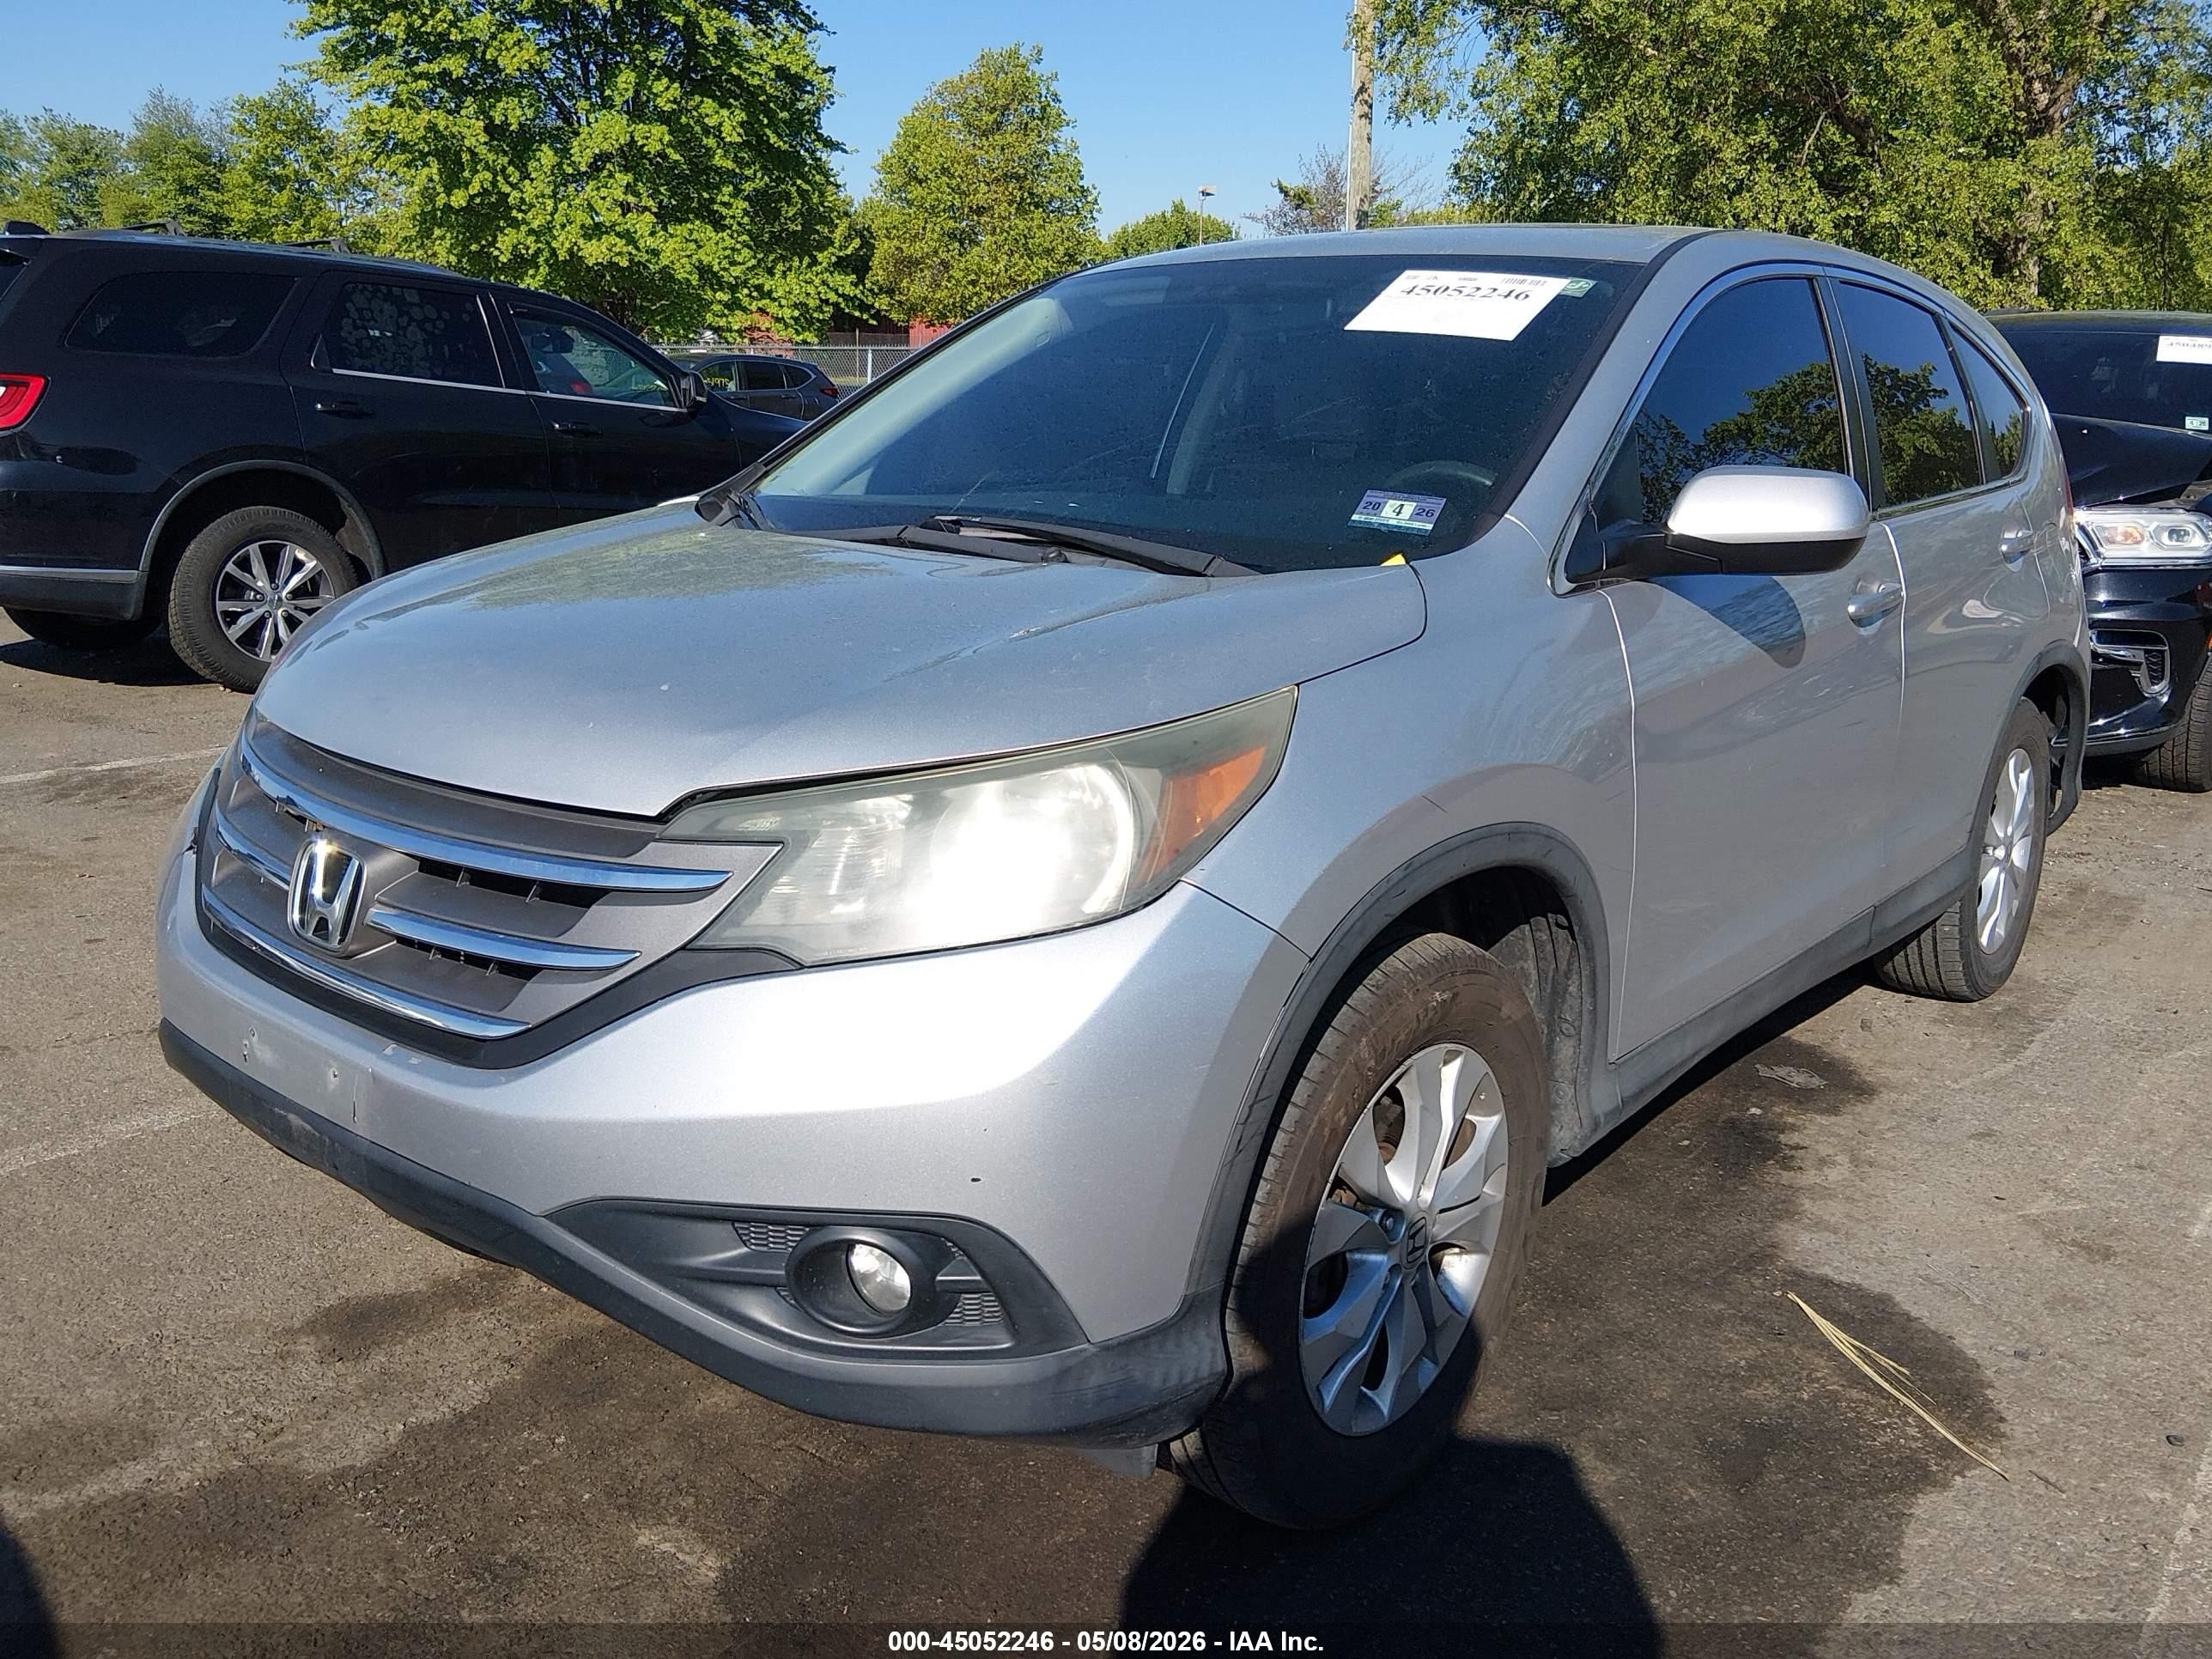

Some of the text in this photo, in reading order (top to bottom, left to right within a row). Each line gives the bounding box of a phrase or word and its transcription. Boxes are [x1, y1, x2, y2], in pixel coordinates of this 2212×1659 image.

[1401, 284, 1531, 301] 45052246
[1362, 501, 1436, 518] 20 4 26
